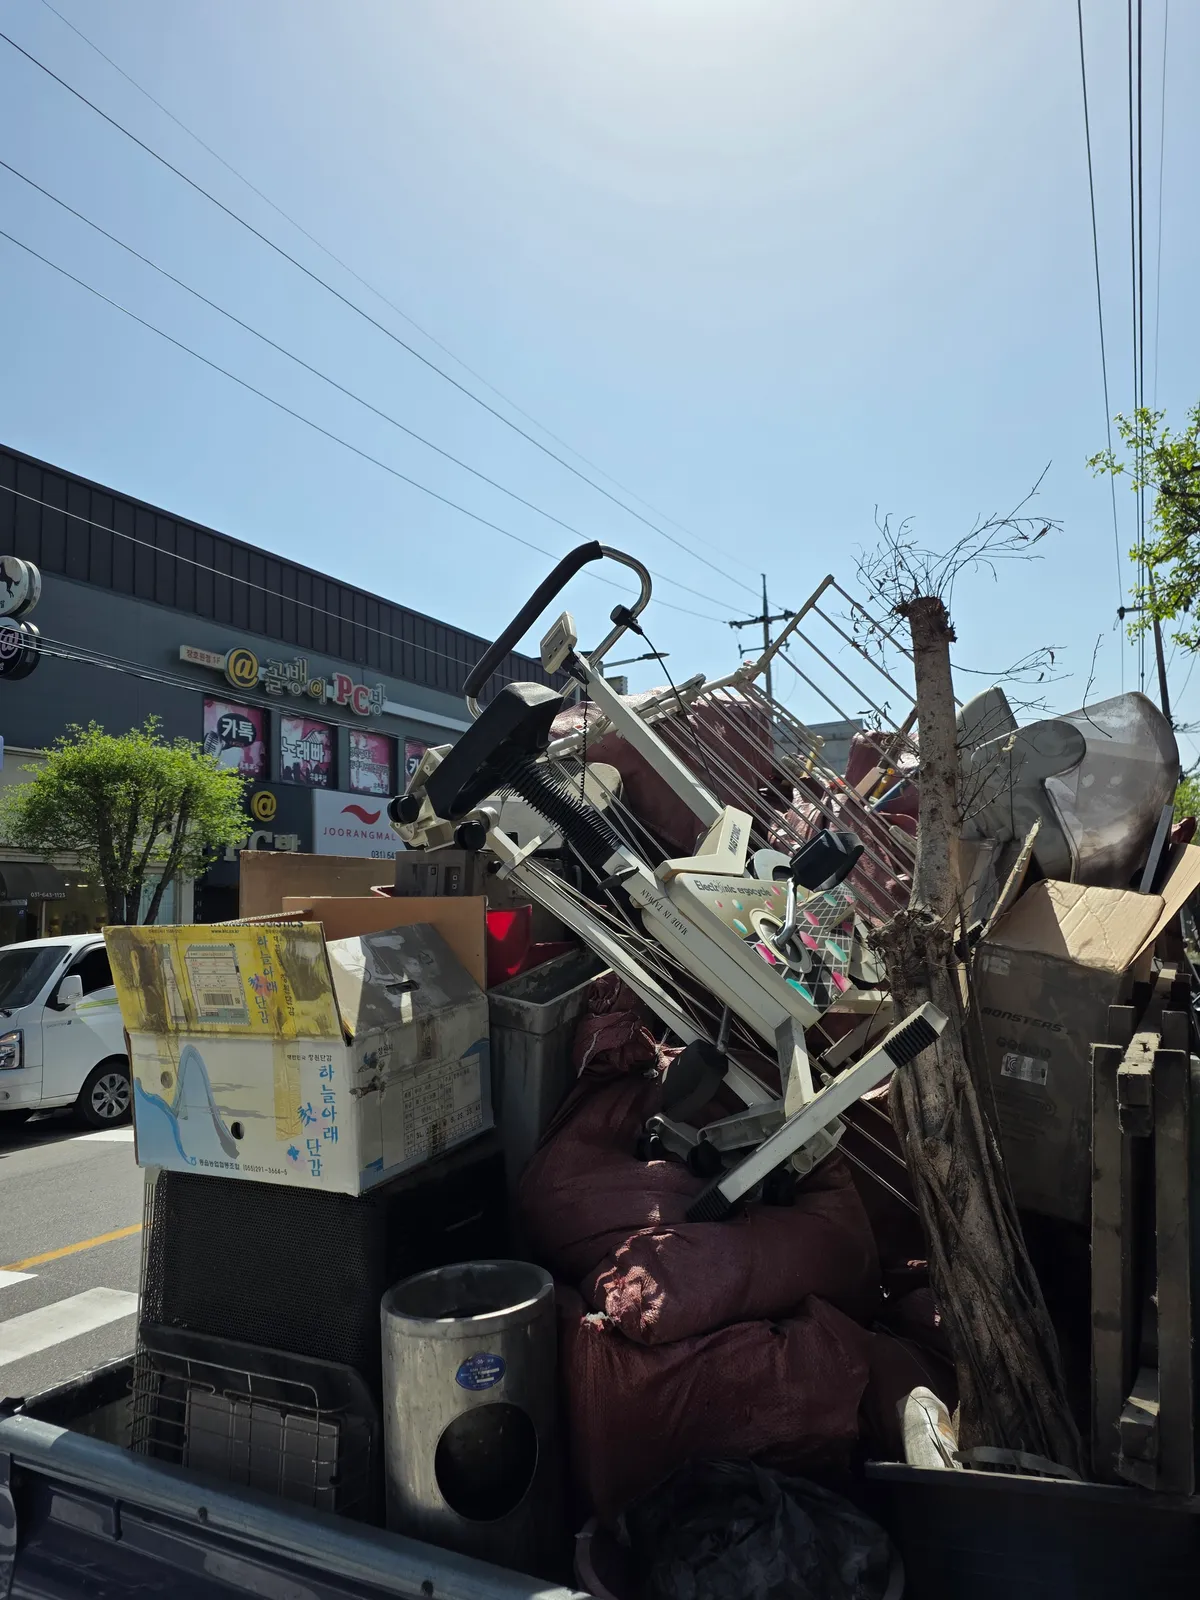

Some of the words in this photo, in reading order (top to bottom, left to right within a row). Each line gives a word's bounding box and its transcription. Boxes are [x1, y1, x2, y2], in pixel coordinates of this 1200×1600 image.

[221, 717, 254, 742] 카톡
[640, 889, 663, 911] TAIWAN
[663, 910, 672, 919] IN
[671, 917, 688, 935] MADE
[319, 1064, 339, 1144] 하늘아래
[306, 1138, 323, 1177] 단감
